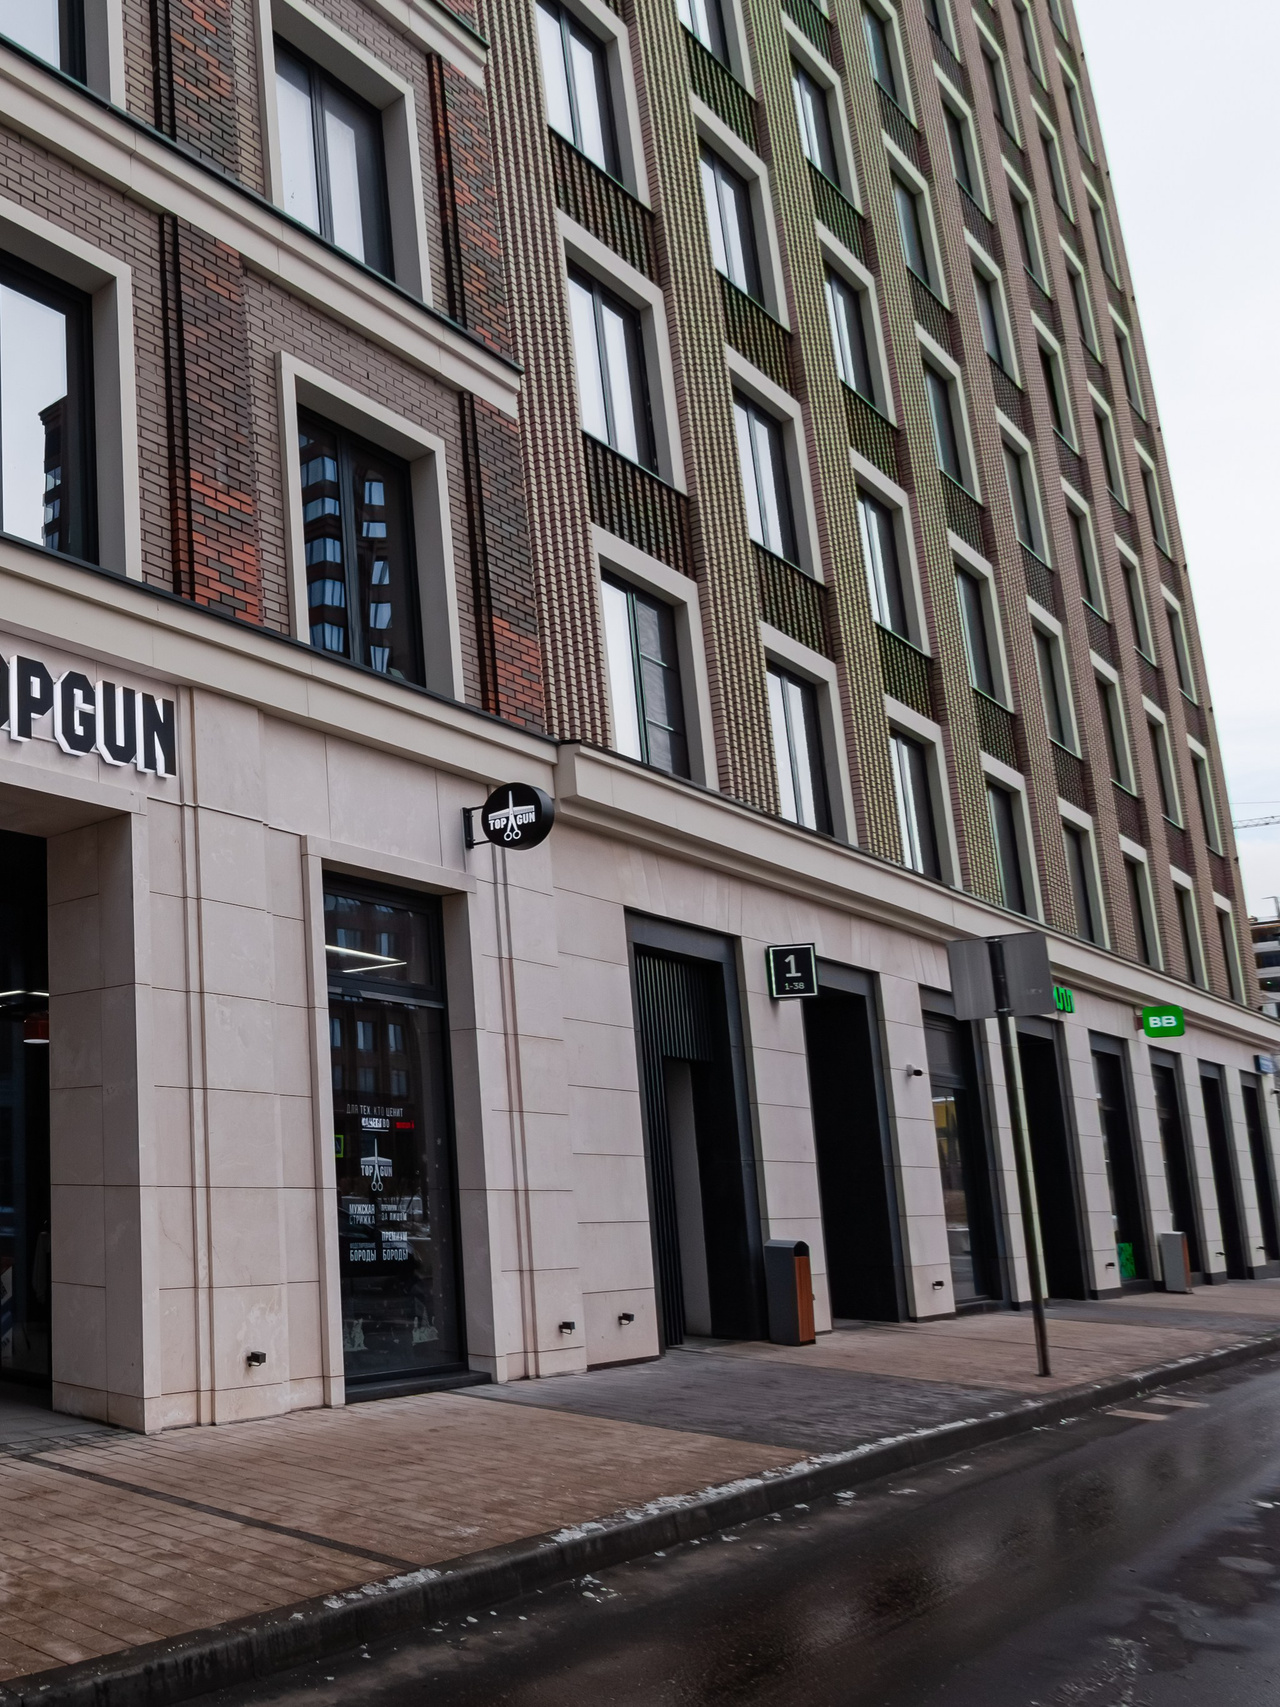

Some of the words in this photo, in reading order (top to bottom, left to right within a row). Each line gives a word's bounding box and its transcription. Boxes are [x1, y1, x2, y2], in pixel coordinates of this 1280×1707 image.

[488, 818, 507, 831] TOP
[516, 811, 536, 825] GUN
[784, 954, 802, 978] 1
[784, 981, 805, 991] 1-38
[373, 1106, 385, 1117] КТО
[385, 1107, 404, 1118] ЦЕНИТ
[360, 1165, 374, 1176] TOP
[379, 1166, 393, 1177] GUN
[349, 1203, 375, 1215] МУЖСКАЯ
[349, 1214, 376, 1225] СТРИЖКА
[349, 1249, 377, 1262] БОРОДЫ
[382, 1248, 409, 1261] БОРОДЫ
